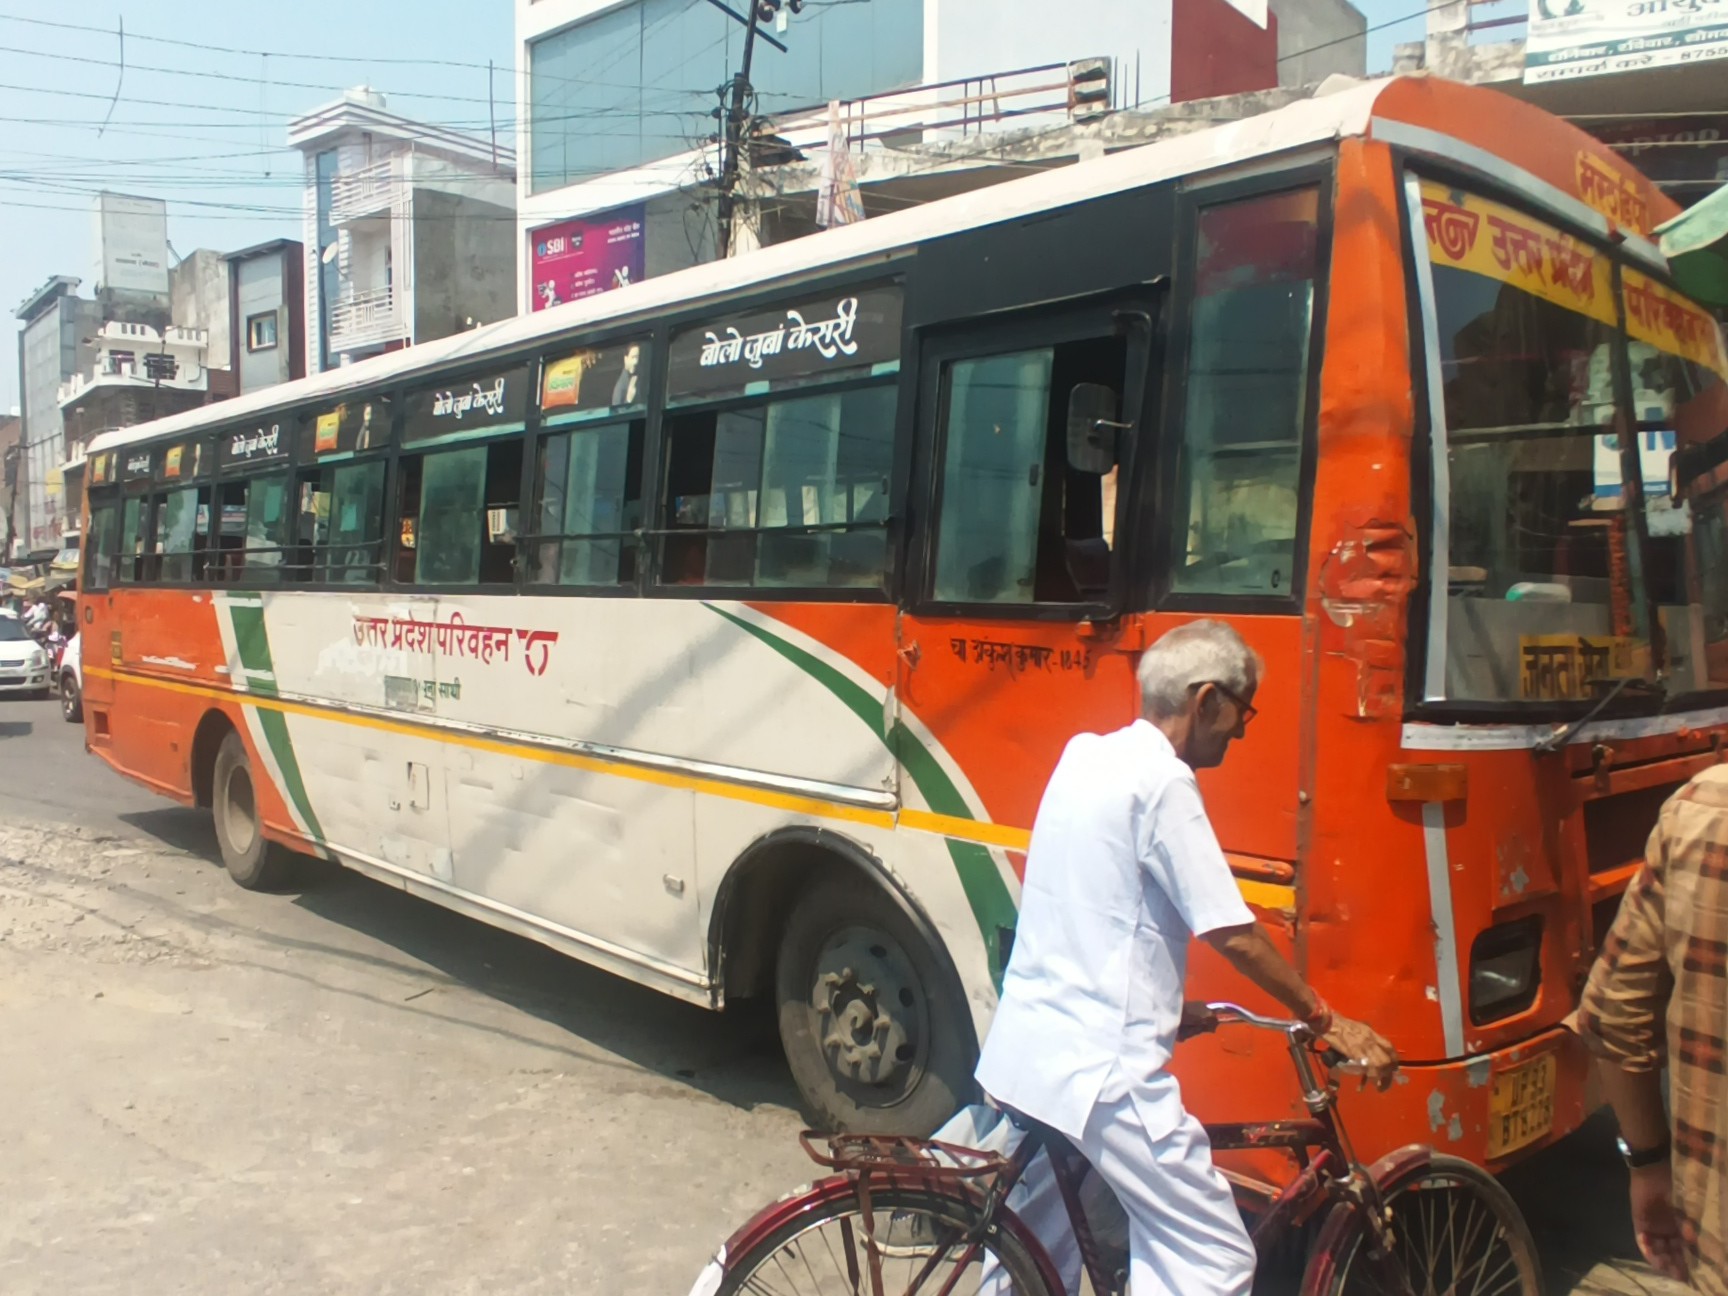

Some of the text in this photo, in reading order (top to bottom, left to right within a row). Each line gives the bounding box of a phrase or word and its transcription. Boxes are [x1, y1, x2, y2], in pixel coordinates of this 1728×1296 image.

[546, 236, 565, 256] SBI
[699, 327, 744, 367] बोलो
[786, 296, 859, 359] केसरी
[472, 377, 505, 416] केसरी
[391, 608, 434, 654] प्रदेश
[434, 611, 514, 665] परिवहन
